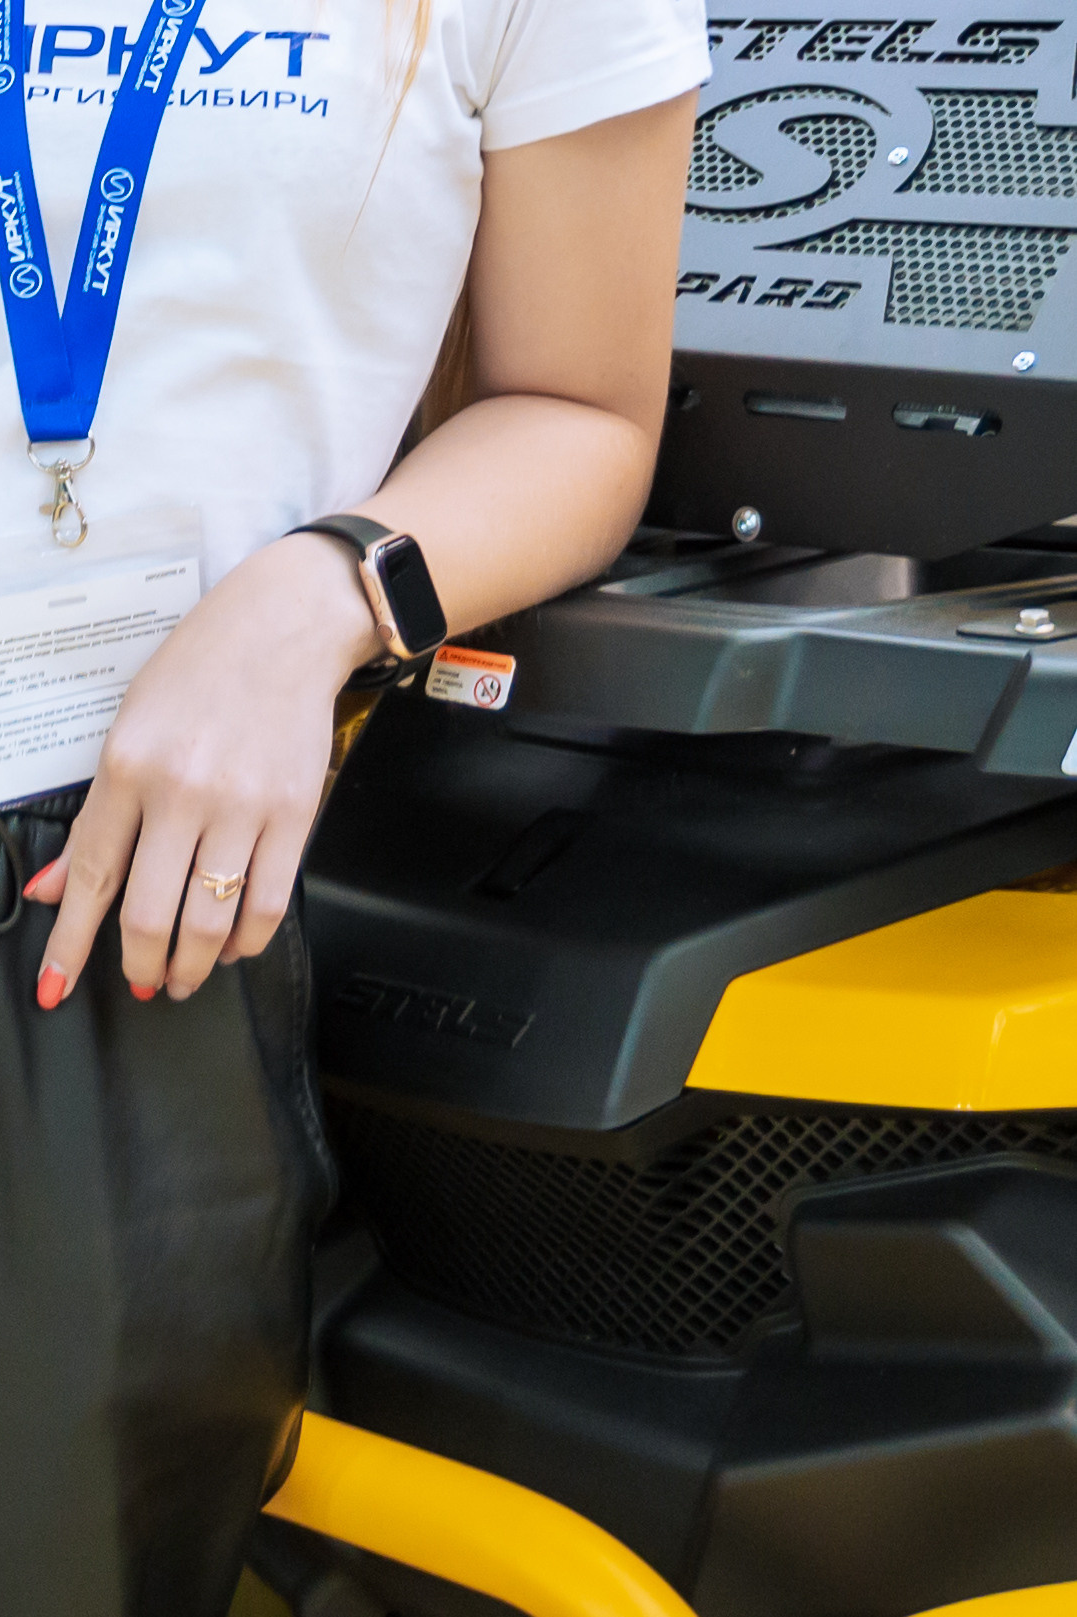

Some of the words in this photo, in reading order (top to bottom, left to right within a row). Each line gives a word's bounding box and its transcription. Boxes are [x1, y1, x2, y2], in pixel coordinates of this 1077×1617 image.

[143, 17, 184, 94] ИРКУТ
[167, 87, 330, 118] ИБИРИ
[92, 204, 125, 296] ИРКУТ
[675, 271, 863, 311] PARD
